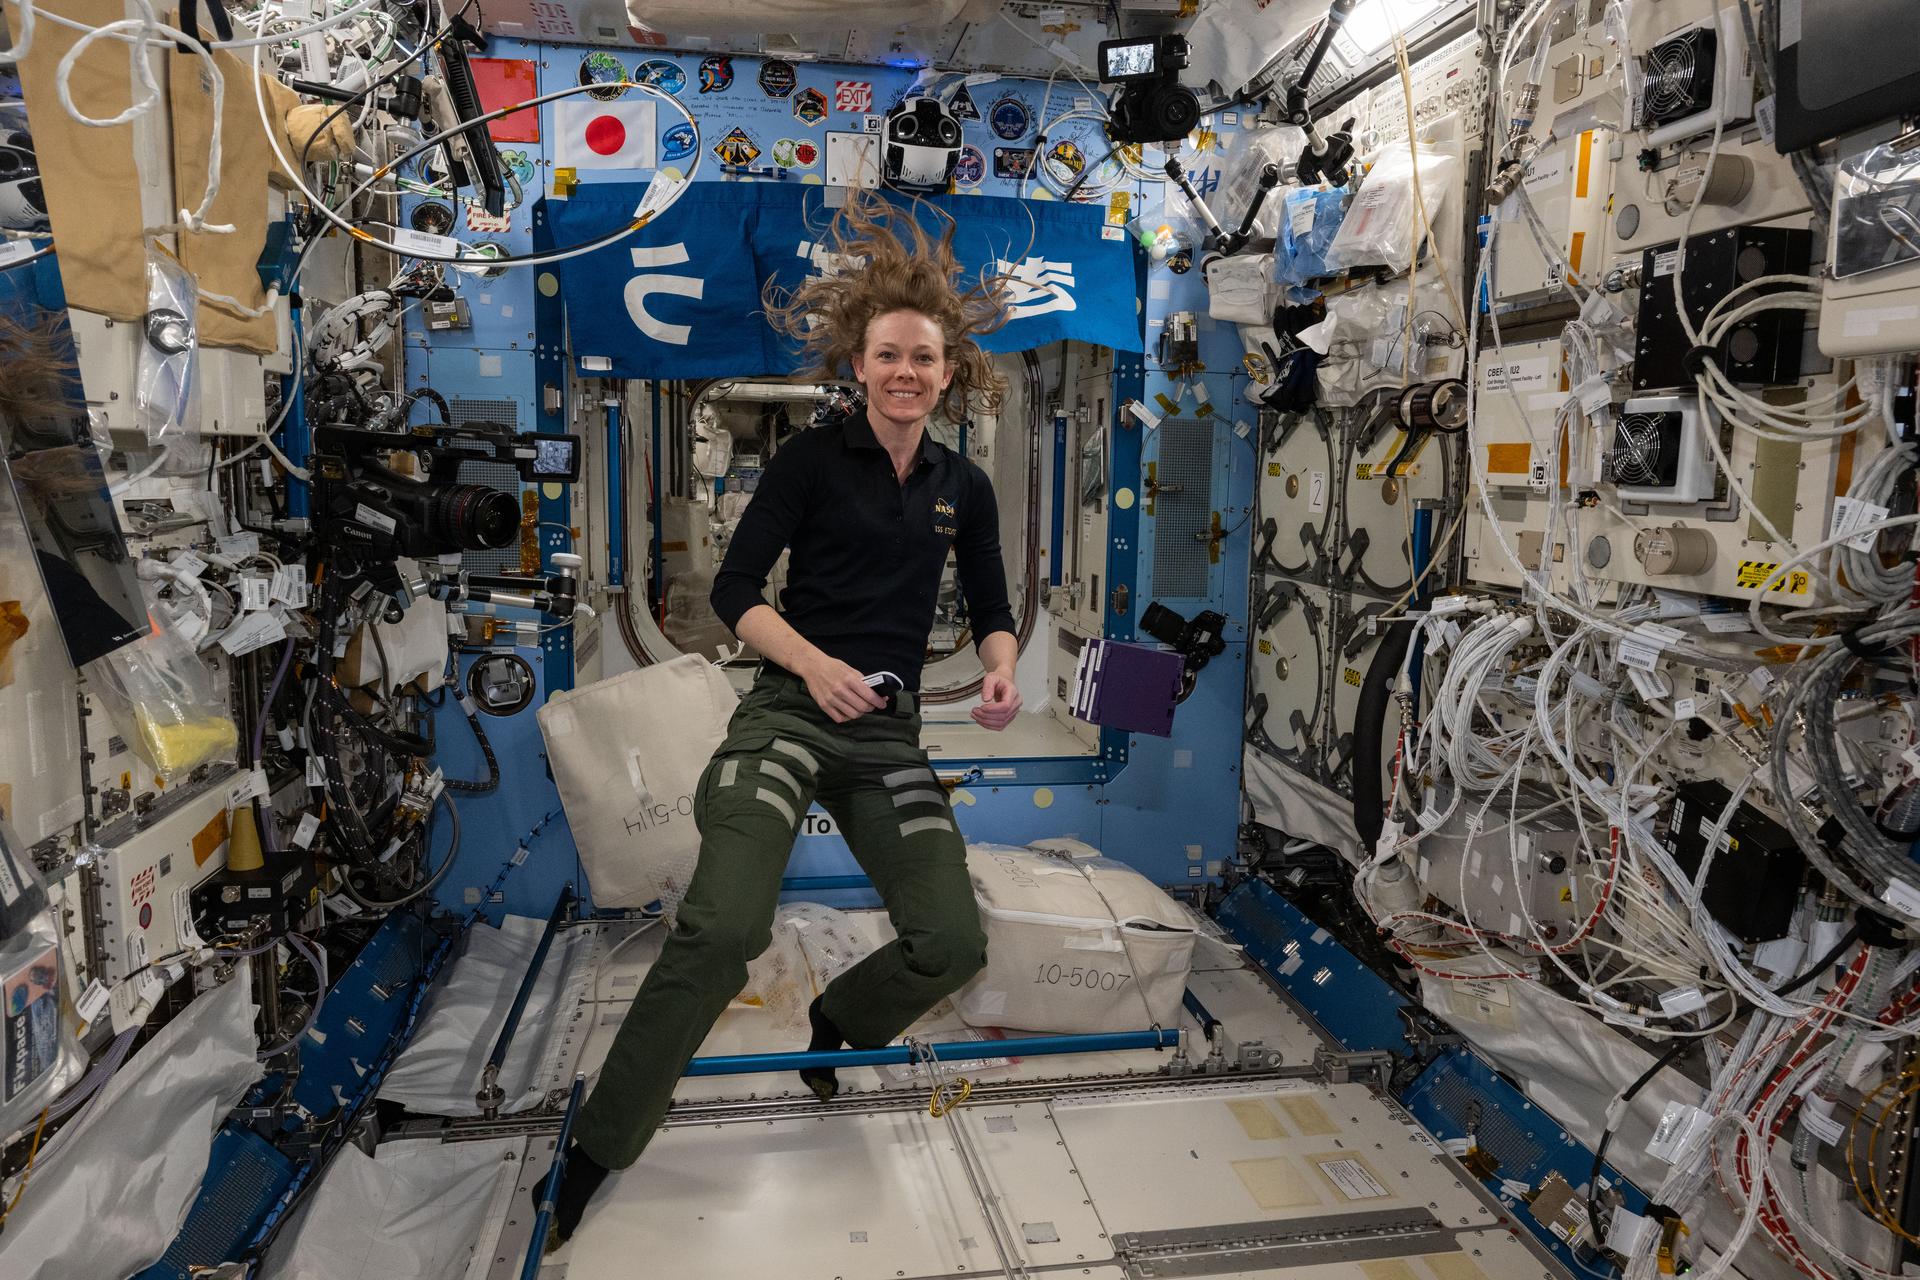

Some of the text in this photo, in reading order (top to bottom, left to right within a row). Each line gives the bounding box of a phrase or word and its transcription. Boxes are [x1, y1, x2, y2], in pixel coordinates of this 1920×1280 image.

[841, 88, 867, 106] EXIT
[1312, 479, 1322, 506] 2
[935, 504, 956, 515] NASA
[343, 526, 373, 541] Canon
[1033, 962, 1131, 993] 1.0-5007
[1414, 1131, 1430, 1143] EPS
